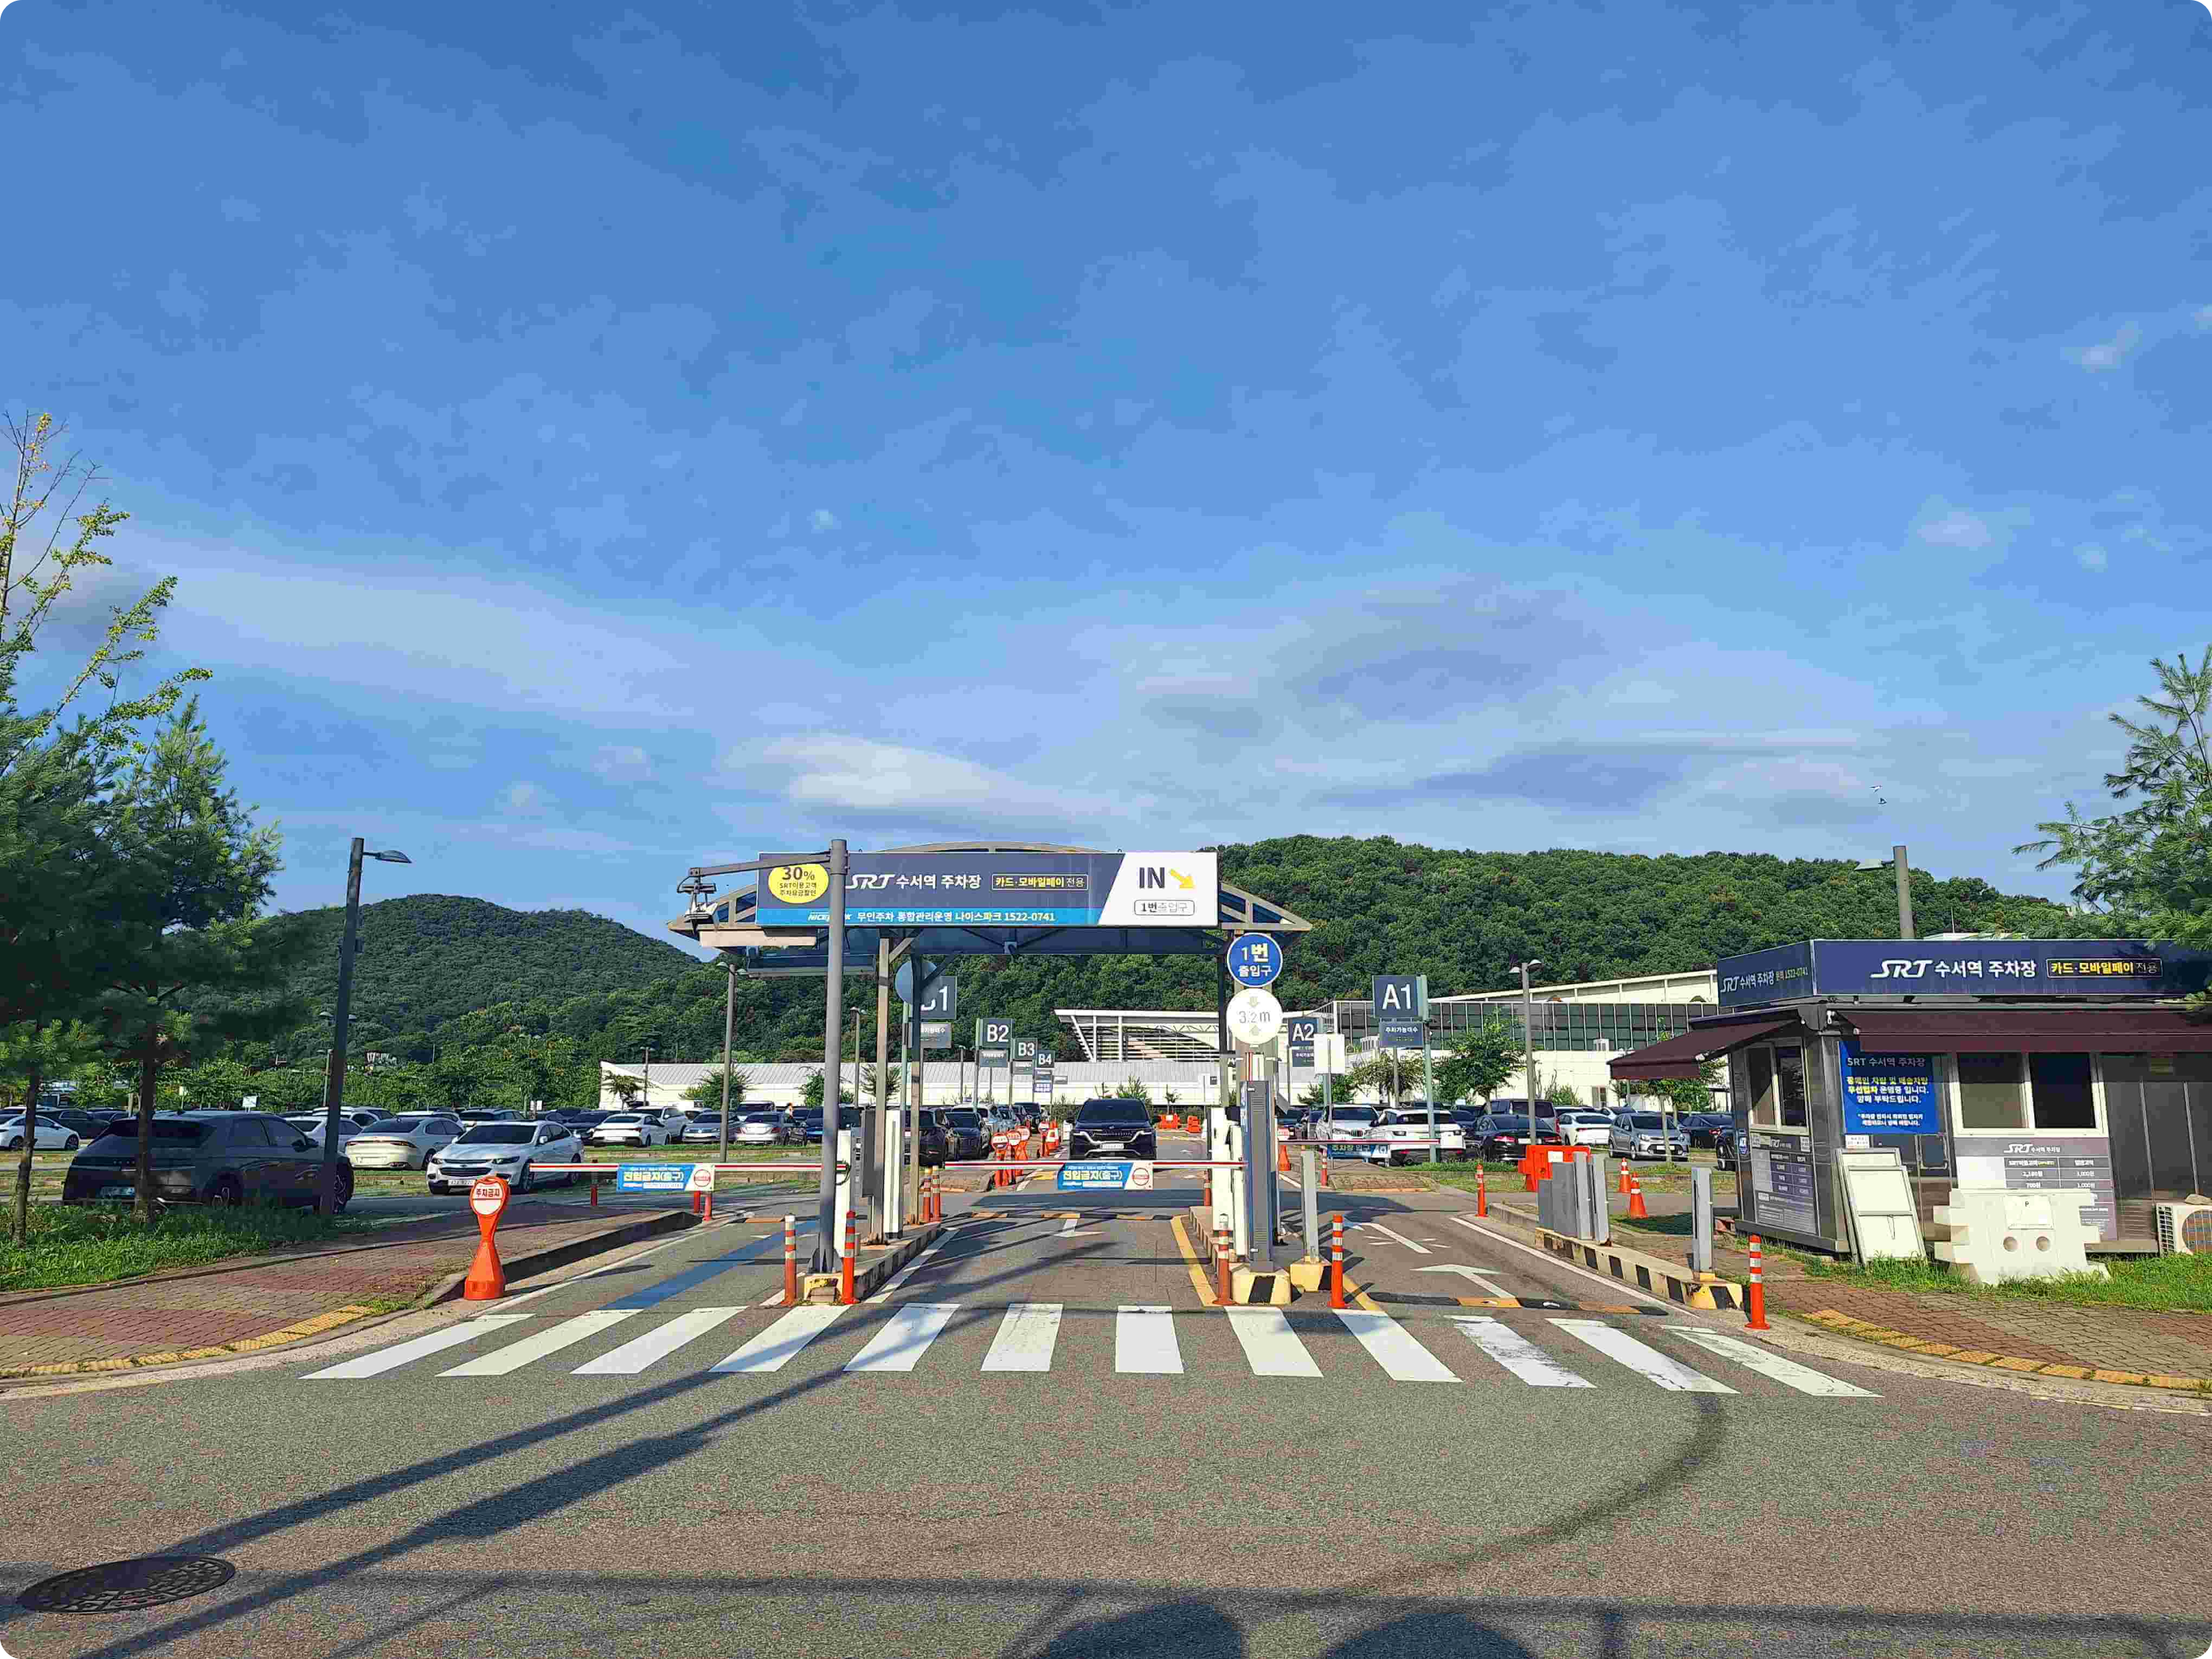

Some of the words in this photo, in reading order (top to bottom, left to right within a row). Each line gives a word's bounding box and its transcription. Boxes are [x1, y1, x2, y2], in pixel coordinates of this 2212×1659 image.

[782, 867, 815, 881] 30%
[846, 874, 895, 889] SRT
[896, 874, 936, 889] 수서역
[941, 874, 981, 889] 주차장
[1139, 867, 1165, 888] IN
[858, 911, 894, 922] 무인주차
[1005, 912, 1055, 922] 1522-0741
[1241, 943, 1268, 962] 1번
[1239, 965, 1272, 977] 출입구
[1870, 960, 1933, 978] SRT
[1935, 960, 1982, 978] 수서역
[1989, 960, 2037, 978] 주차장
[1720, 976, 1739, 992] SRT
[1740, 973, 1756, 989] 수서역
[1758, 970, 1774, 987] 주차장
[1382, 984, 1412, 1009] A1
[987, 1024, 1009, 1042] B2
[1293, 1023, 1315, 1041] A2
[1018, 1042, 1034, 1056] B3
[1038, 1053, 1051, 1065] B4
[1847, 1057, 1866, 1066] SRT
[1869, 1057, 1895, 1067] 수서역
[1899, 1057, 1925, 1067] 주차장
[2003, 1144, 2033, 1153] SRT
